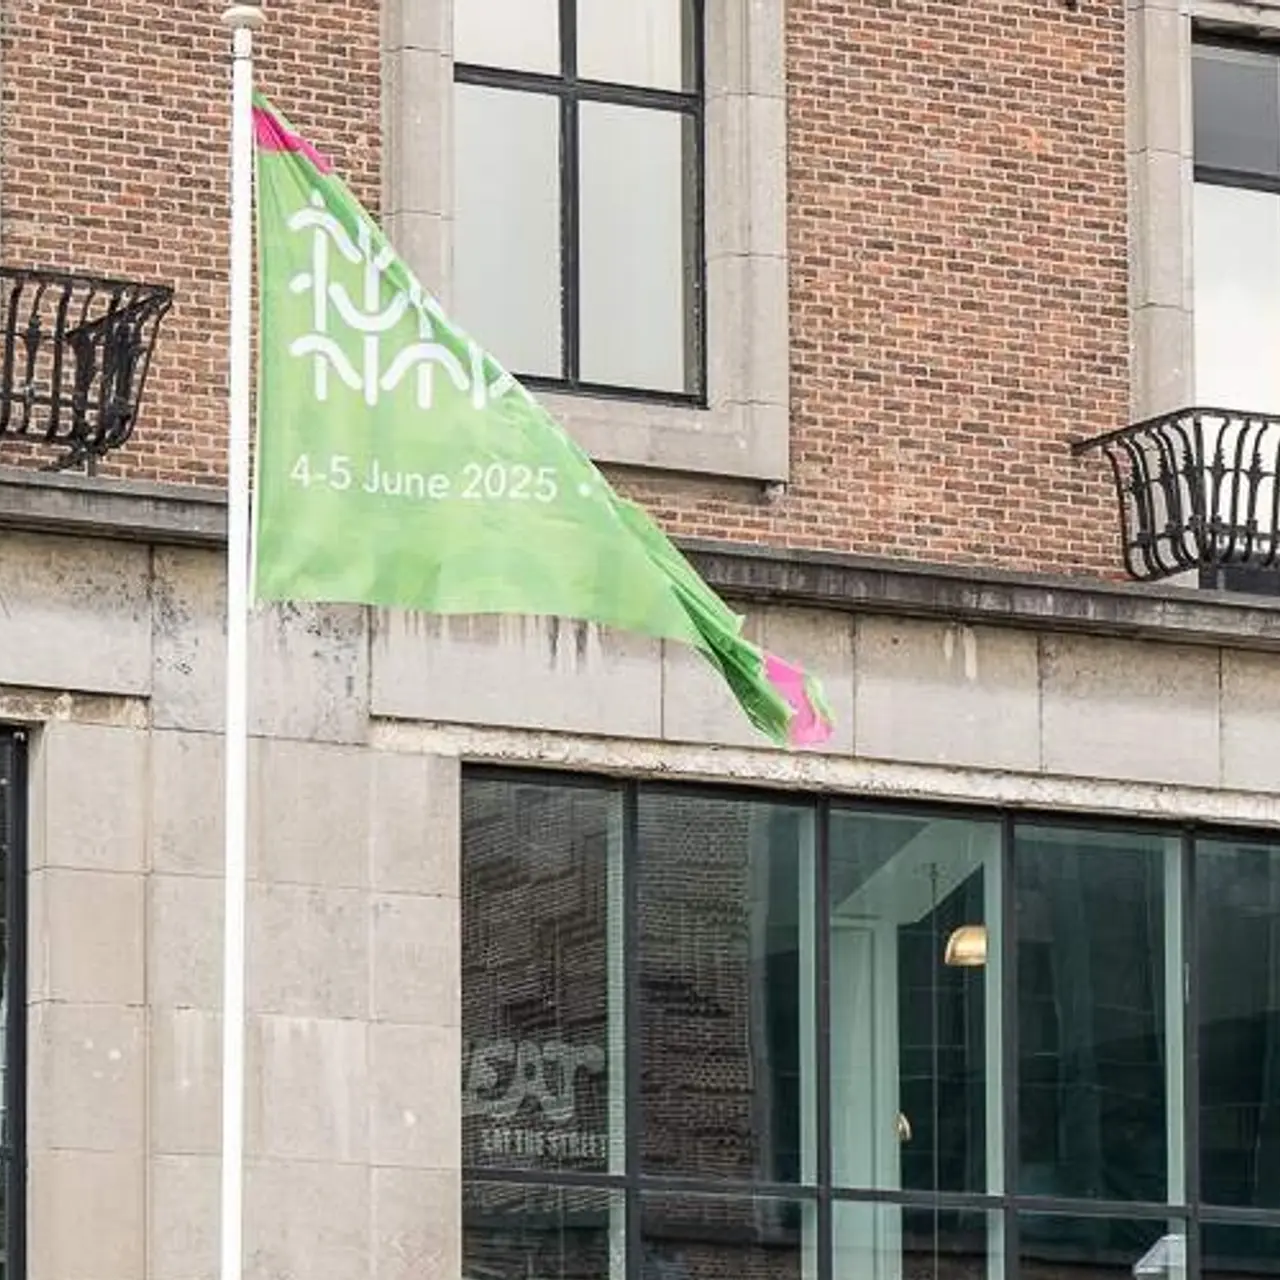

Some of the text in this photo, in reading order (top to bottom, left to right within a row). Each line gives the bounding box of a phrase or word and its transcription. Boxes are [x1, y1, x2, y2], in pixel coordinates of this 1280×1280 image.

[290, 453, 558, 503] 4-5 June 2025
